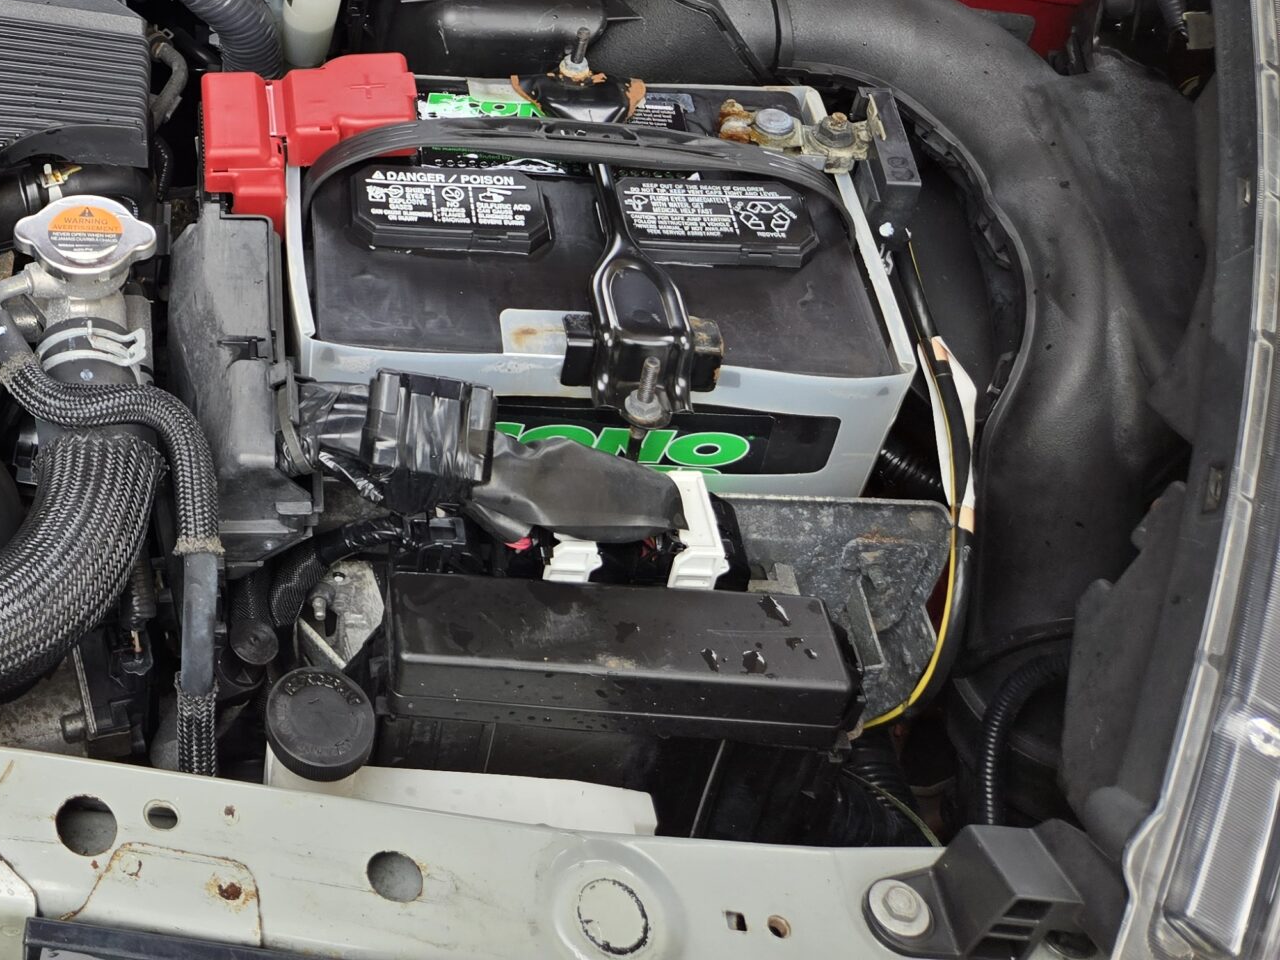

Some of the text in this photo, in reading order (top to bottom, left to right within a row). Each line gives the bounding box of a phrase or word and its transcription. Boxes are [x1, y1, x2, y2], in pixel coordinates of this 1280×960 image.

[386, 171, 445, 182] DANGER
[461, 175, 514, 185] POISON
[388, 197, 428, 206] EXPLOSIVE
[389, 203, 413, 211] GASES
[476, 201, 531, 211] SULFURIC ACID
[63, 217, 108, 225] WARNING
[442, 216, 471, 224] SMOKING
[503, 219, 525, 227] BURNS
[53, 224, 120, 232] AVERTISSEMENT
